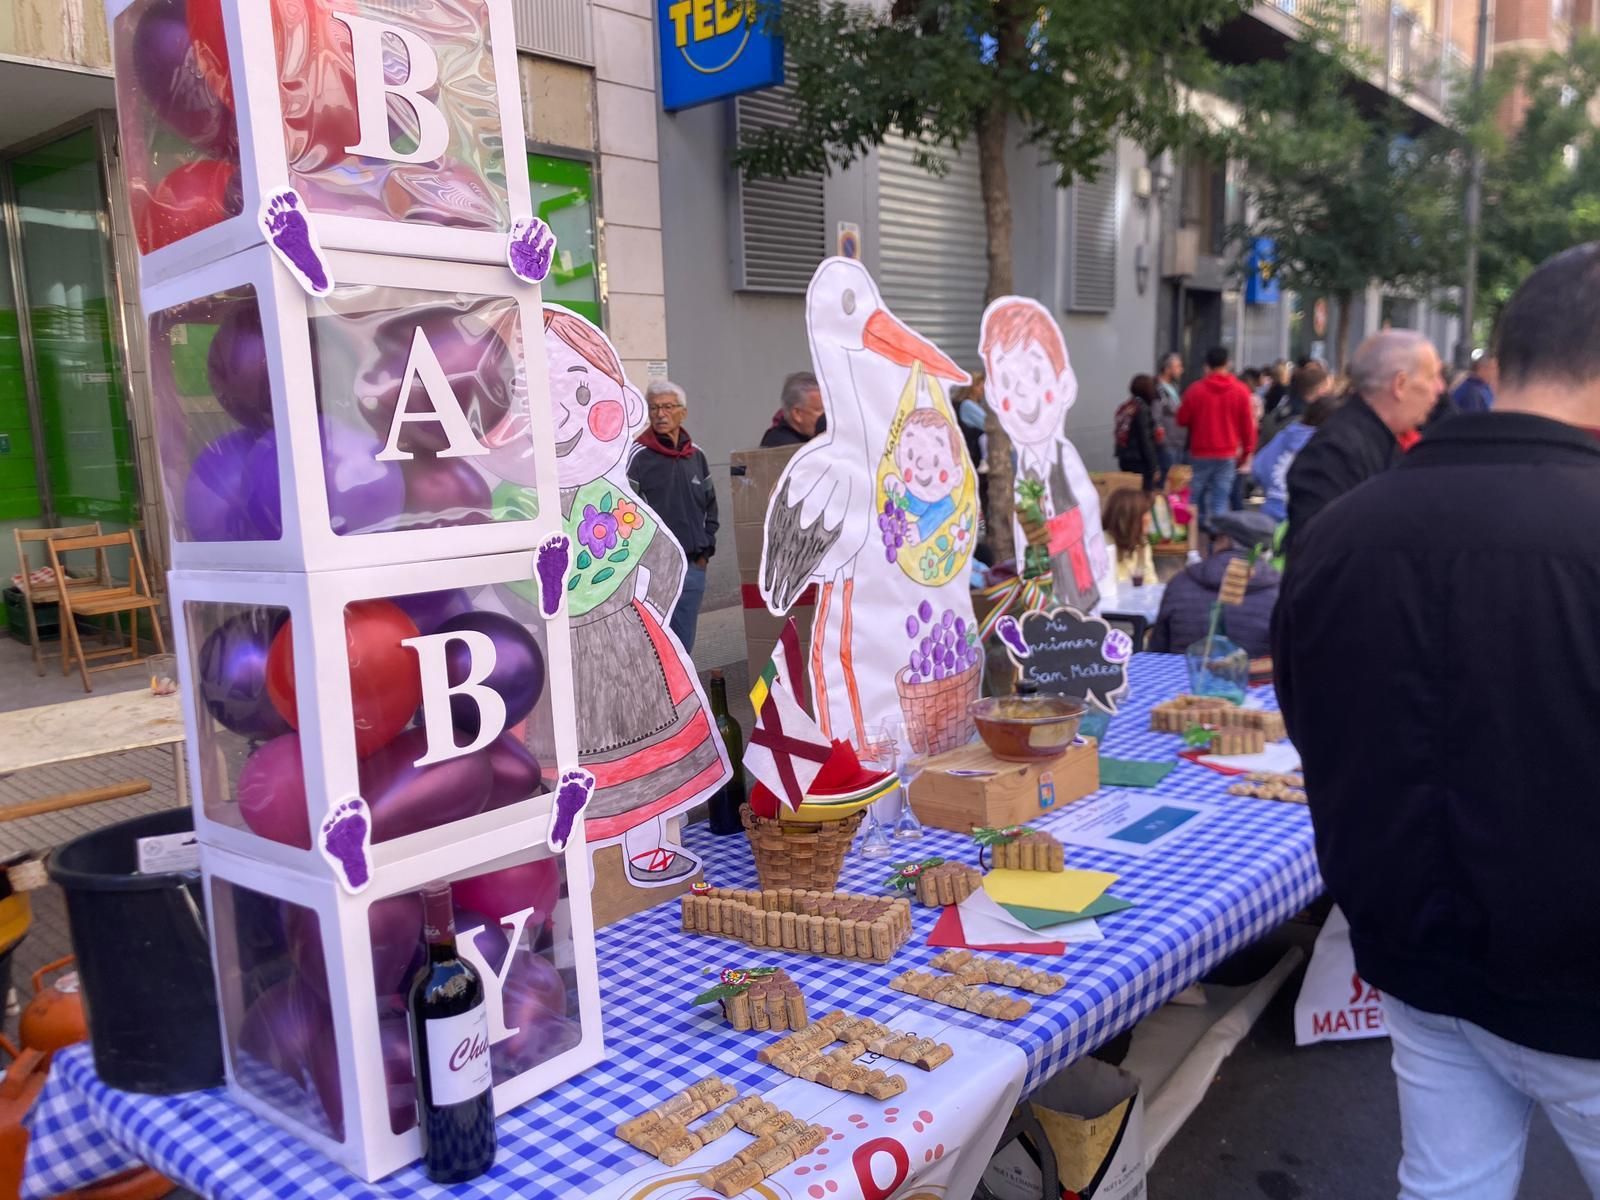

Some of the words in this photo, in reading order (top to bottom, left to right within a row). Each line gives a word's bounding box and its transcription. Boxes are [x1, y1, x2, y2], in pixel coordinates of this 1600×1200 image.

[1029, 667, 1068, 682] San
[1070, 664, 1121, 679] Mateo
[1349, 972, 1383, 1005] SA
[1313, 1007, 1384, 1036] MATE
